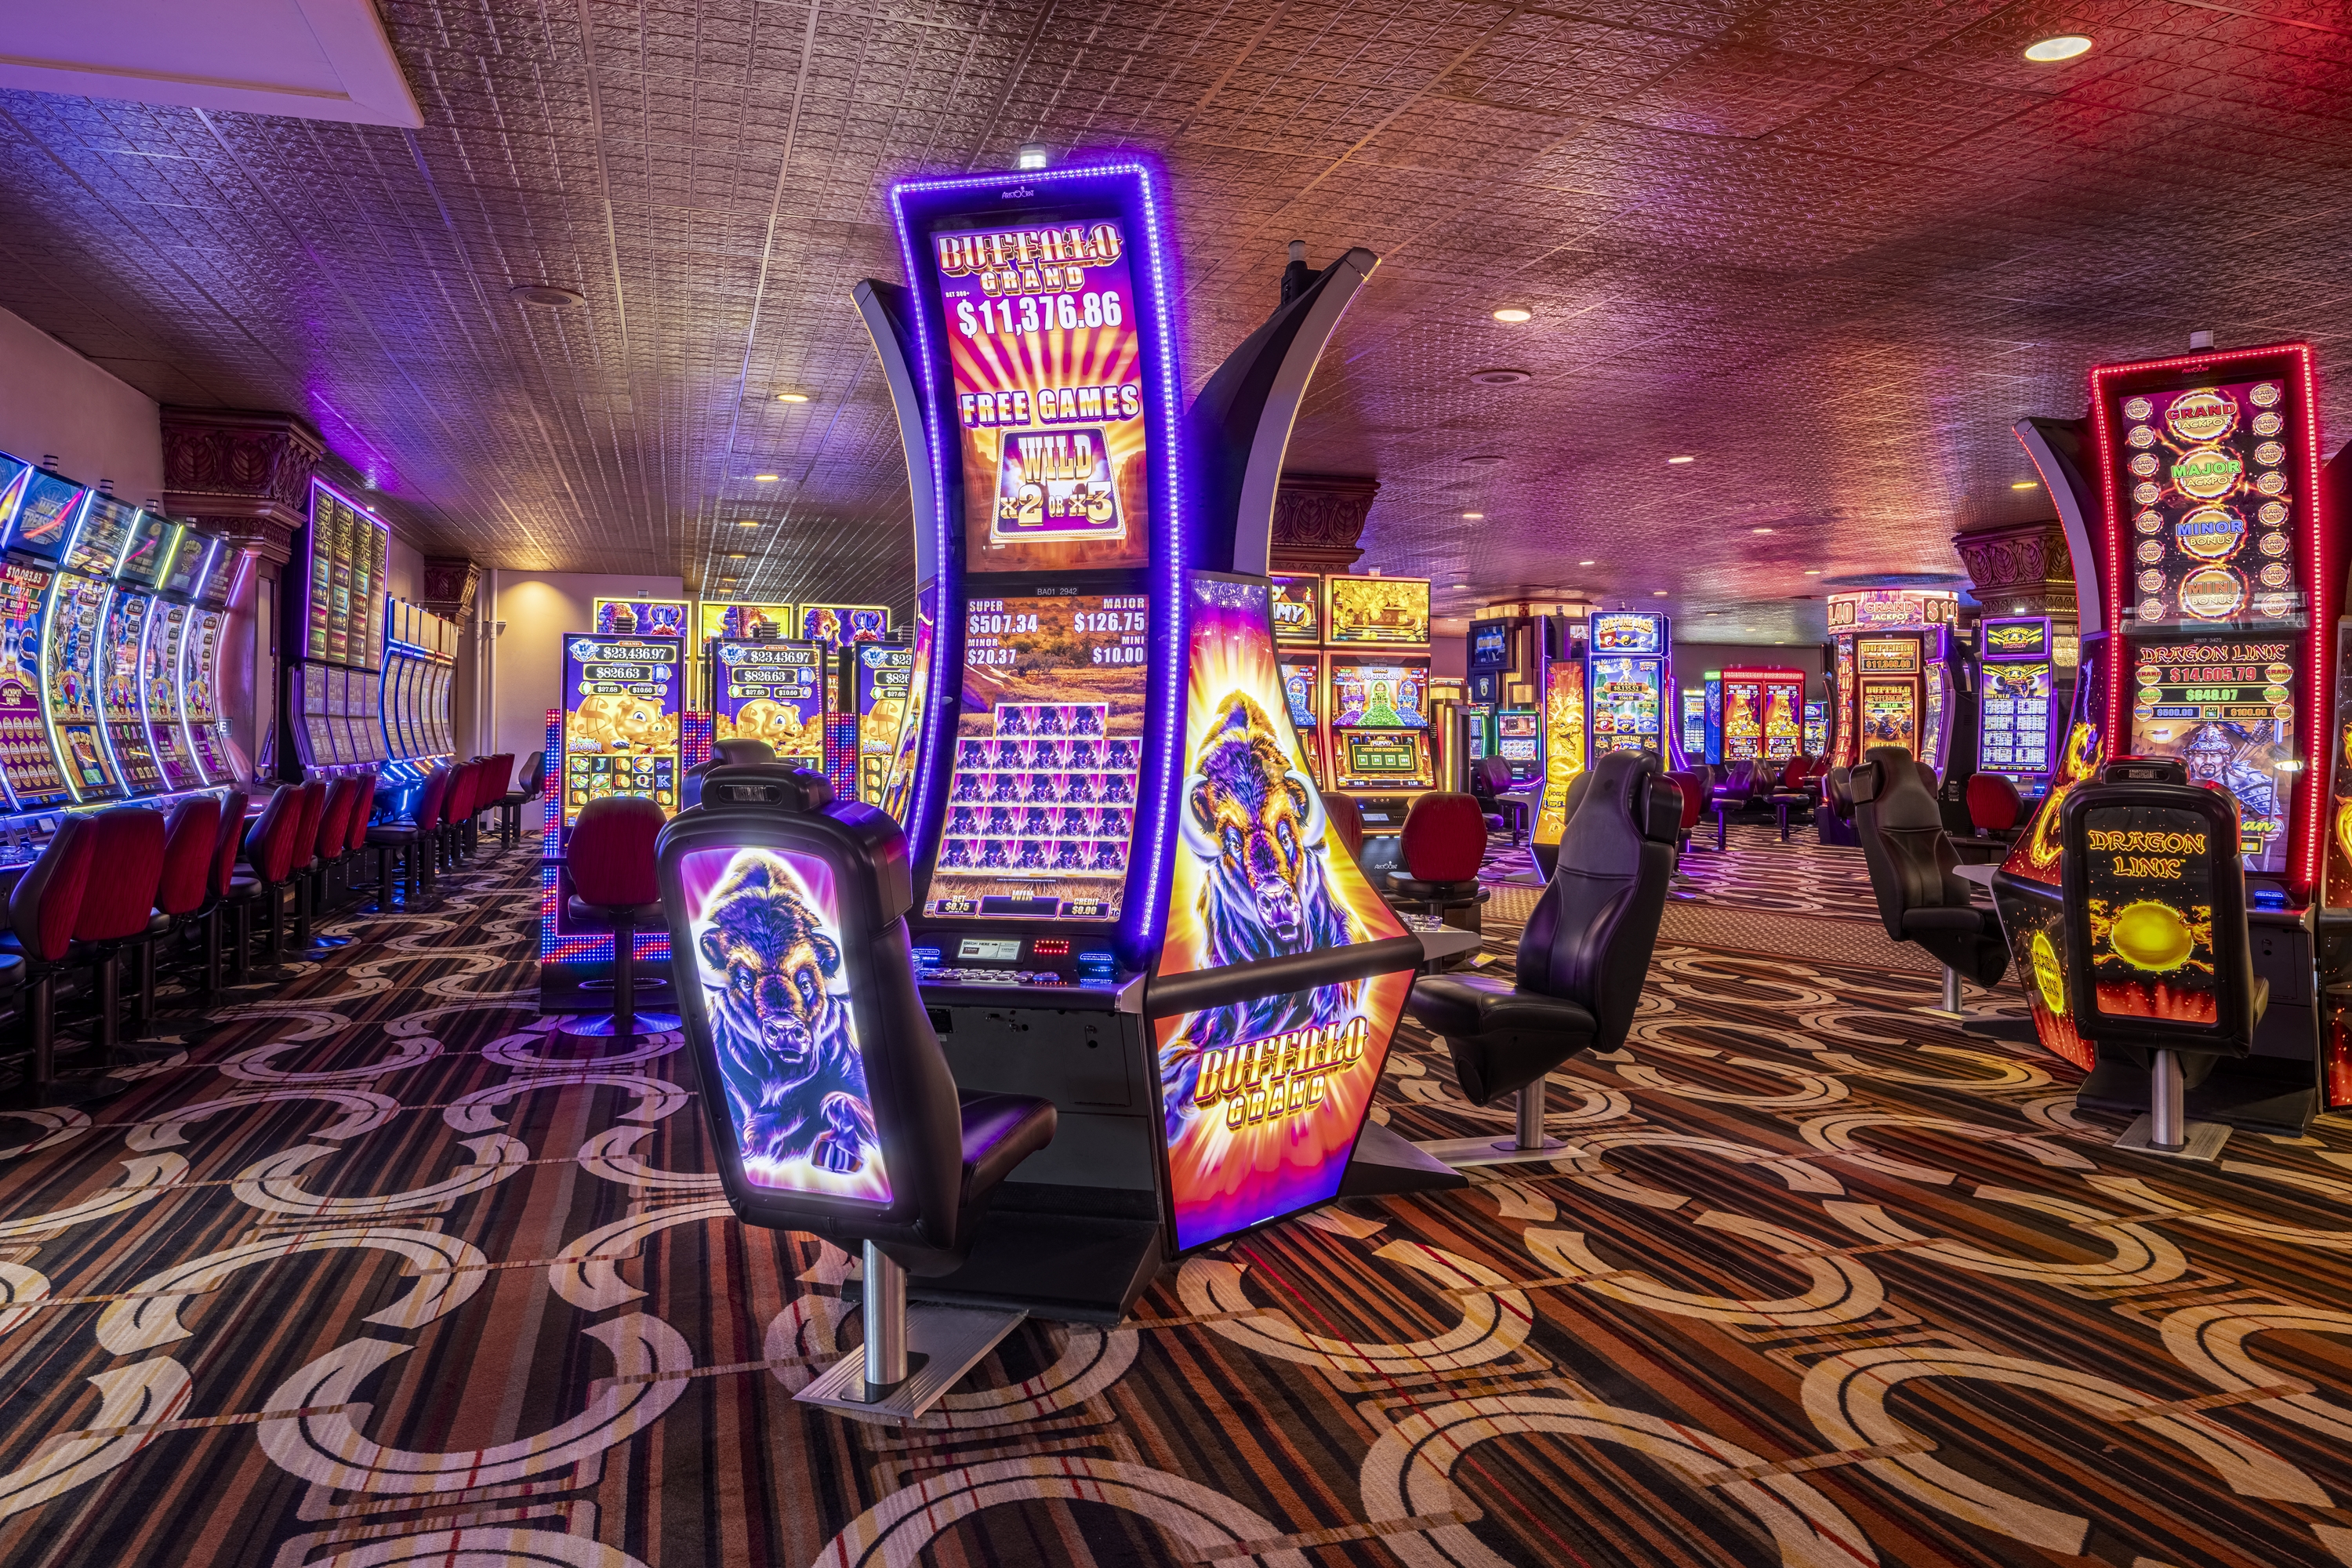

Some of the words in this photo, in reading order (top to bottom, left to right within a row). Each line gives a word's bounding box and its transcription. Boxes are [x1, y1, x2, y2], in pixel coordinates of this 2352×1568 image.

[1002, 188, 1034, 199] ARISTOCRAT
[938, 224, 1123, 278] BUFFALO
[979, 266, 1085, 299] GRAND
[957, 290, 1123, 338] $11,376.86
[960, 390, 1031, 430] FREE
[1036, 385, 1142, 425] GAMES
[2165, 402, 2236, 421] GRAND
[2176, 417, 2229, 430] JACKPOT
[1018, 434, 1093, 483] WILD
[2171, 460, 2241, 478] MAJOR
[2182, 476, 2233, 487] JACKPOT
[1049, 495, 1065, 518] OR
[2176, 520, 2245, 536] MINOR
[2190, 536, 2233, 546] BONUS
[2186, 580, 2239, 595] MINI
[969, 601, 1003, 613] SUPER
[1103, 598, 1145, 611] MAJOR
[1864, 601, 1915, 613] GRAND
[2191, 597, 2234, 606] BONUS
[969, 614, 1038, 635] $507.34
[1074, 612, 1145, 633] $126.75
[1600, 618, 1633, 633] FORTUNE
[1633, 618, 1653, 633] BAGS
[968, 638, 998, 647] MINOR
[1122, 636, 1145, 645] MINI
[604, 647, 667, 660] $23,436.97
[751, 651, 811, 664] $23,436.97
[967, 649, 1016, 666] $20.37
[1093, 647, 1144, 664] $10.00
[2140, 644, 2229, 664] DRAGON
[1866, 660, 1911, 668] $11,349.40
[596, 667, 640, 679] $826.63
[744, 671, 785, 682] $826.63
[2170, 667, 2257, 683] $14,605.79
[2, 688, 22, 697] JACKPOT
[2186, 689, 2238, 701] $648.07
[2231, 708, 2268, 717] $100.00
[596, 758, 606, 771] J
[2129, 769, 2154, 779] ARISTOCRAT
[636, 775, 650, 788] Q
[656, 775, 671, 788] K
[2087, 829, 2207, 855] DRAGON
[1011, 890, 1034, 901] WIN
[1073, 898, 1100, 906] CREDIT
[945, 902, 970, 911] $0.75
[1072, 906, 1097, 915] $0.00
[2031, 948, 2061, 978] DRAGON
[2040, 973, 2060, 998] LINK
[1193, 1015, 1369, 1111] BUFFALO
[1226, 1075, 1326, 1133] GRAND
